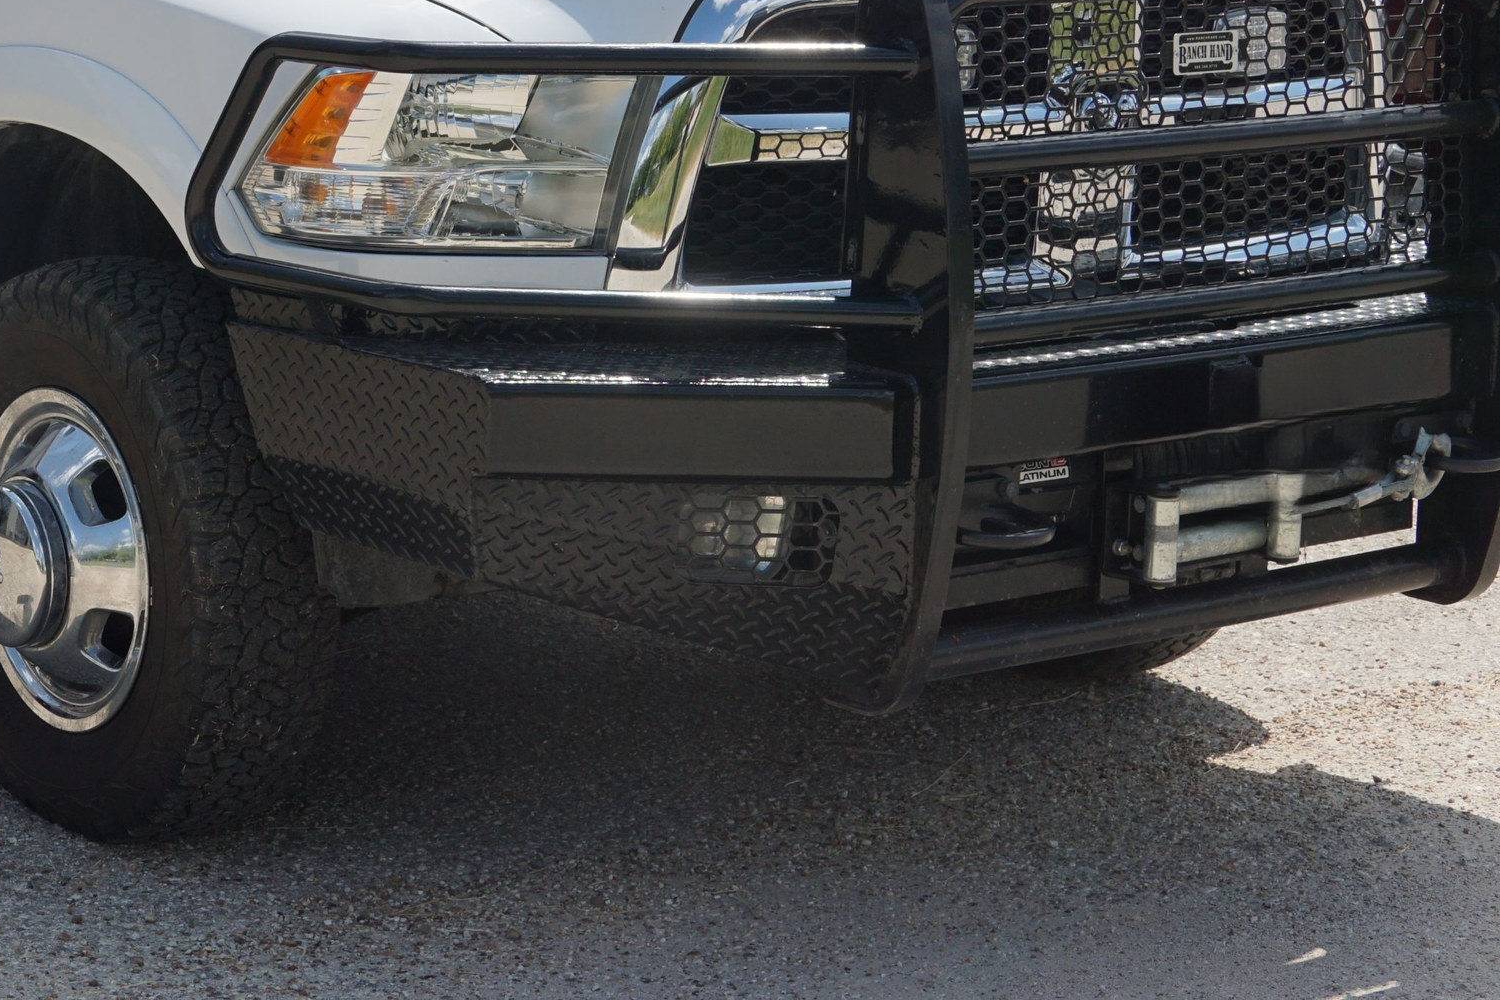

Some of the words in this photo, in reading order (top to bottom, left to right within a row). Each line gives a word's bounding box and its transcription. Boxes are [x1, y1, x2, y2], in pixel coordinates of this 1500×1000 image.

[1179, 45, 1207, 65] RANCH
[1210, 43, 1233, 61] HAND
[1020, 467, 1066, 481] ATINUM
